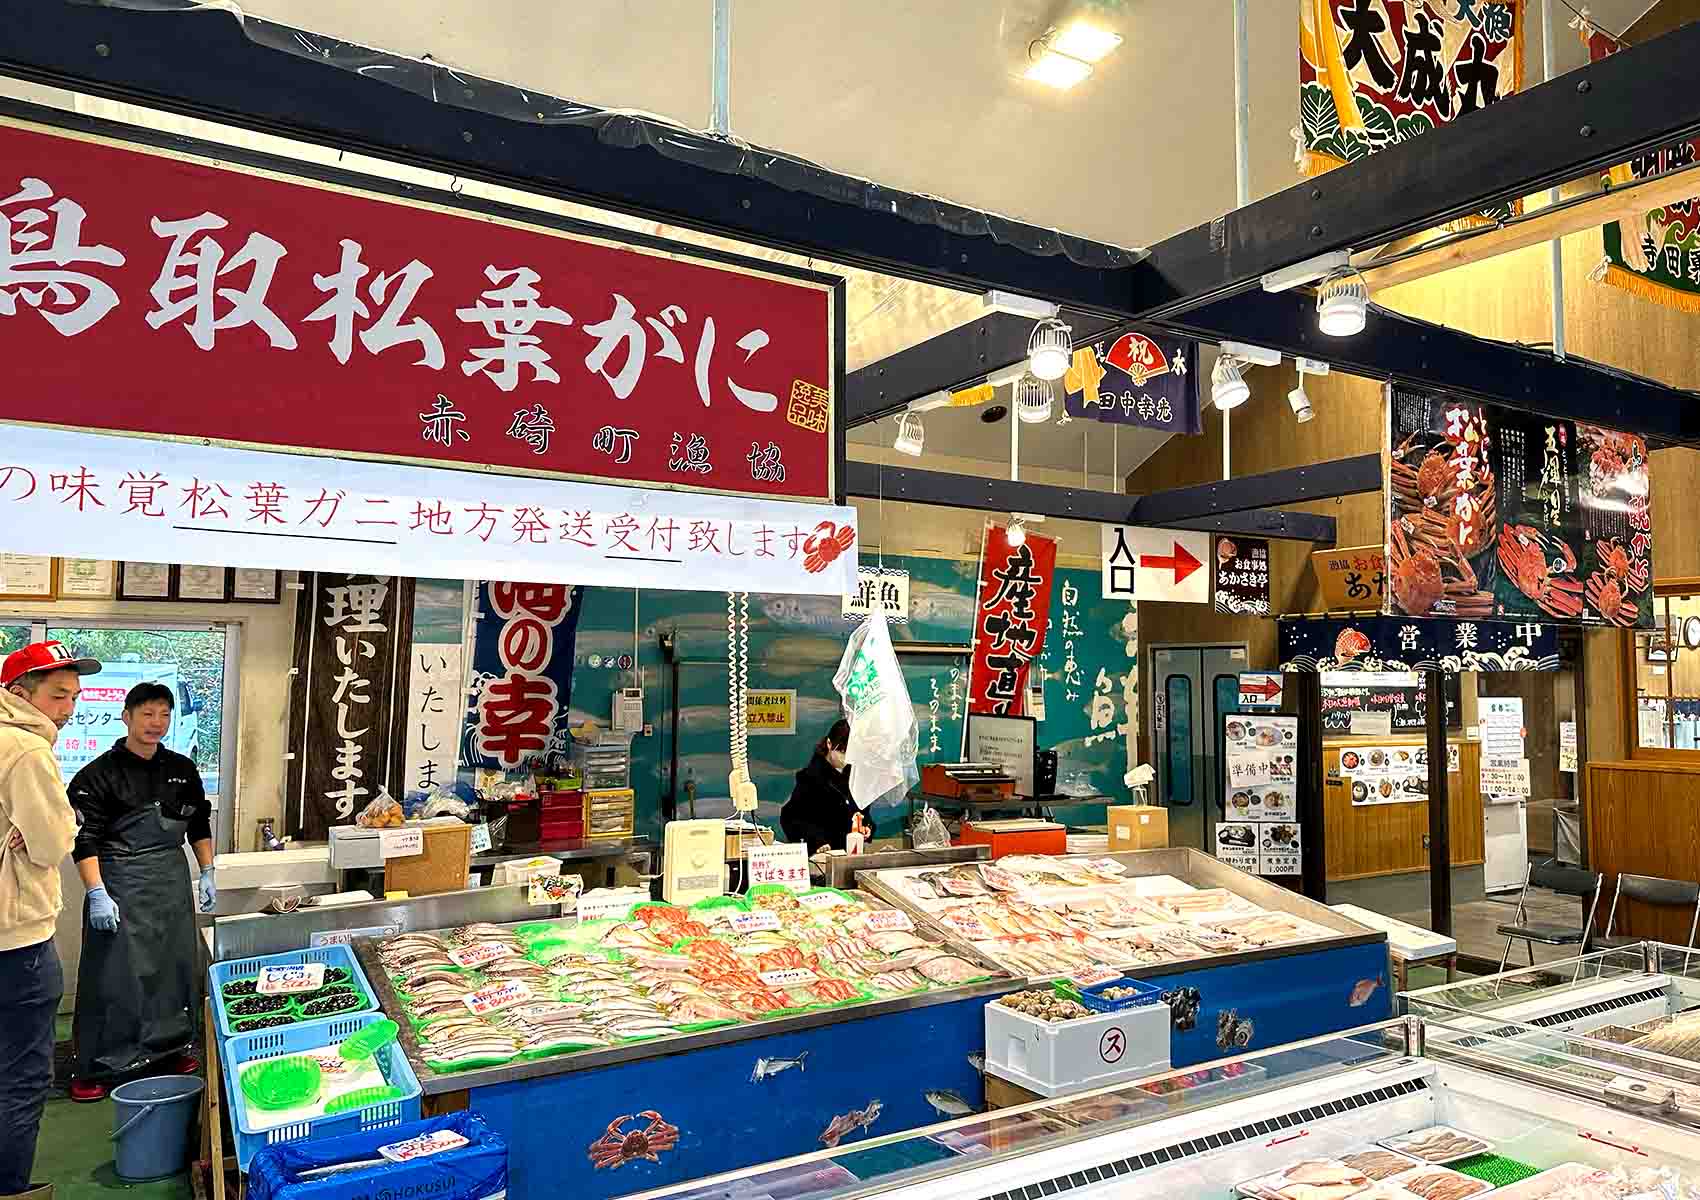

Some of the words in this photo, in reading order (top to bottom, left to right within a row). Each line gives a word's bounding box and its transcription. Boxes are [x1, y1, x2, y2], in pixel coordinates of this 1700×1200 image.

[0, 177, 779, 413] 鳥取松葉がに
[1127, 335, 1155, 365] 祝
[419, 394, 787, 484] 赤碕町漁協
[1109, 528, 1136, 593] 入口
[1218, 570, 1268, 588] あかさき亭
[850, 580, 901, 612] 鮮魚
[983, 544, 1041, 713] 産地直
[1398, 622, 1542, 650] 営業中
[323, 574, 389, 820] 理いたします
[1241, 694, 1258, 703] 入口
[67, 711, 123, 726] センター
[1232, 762, 1268, 776] 準備中
[754, 866, 807, 881] さばきます
